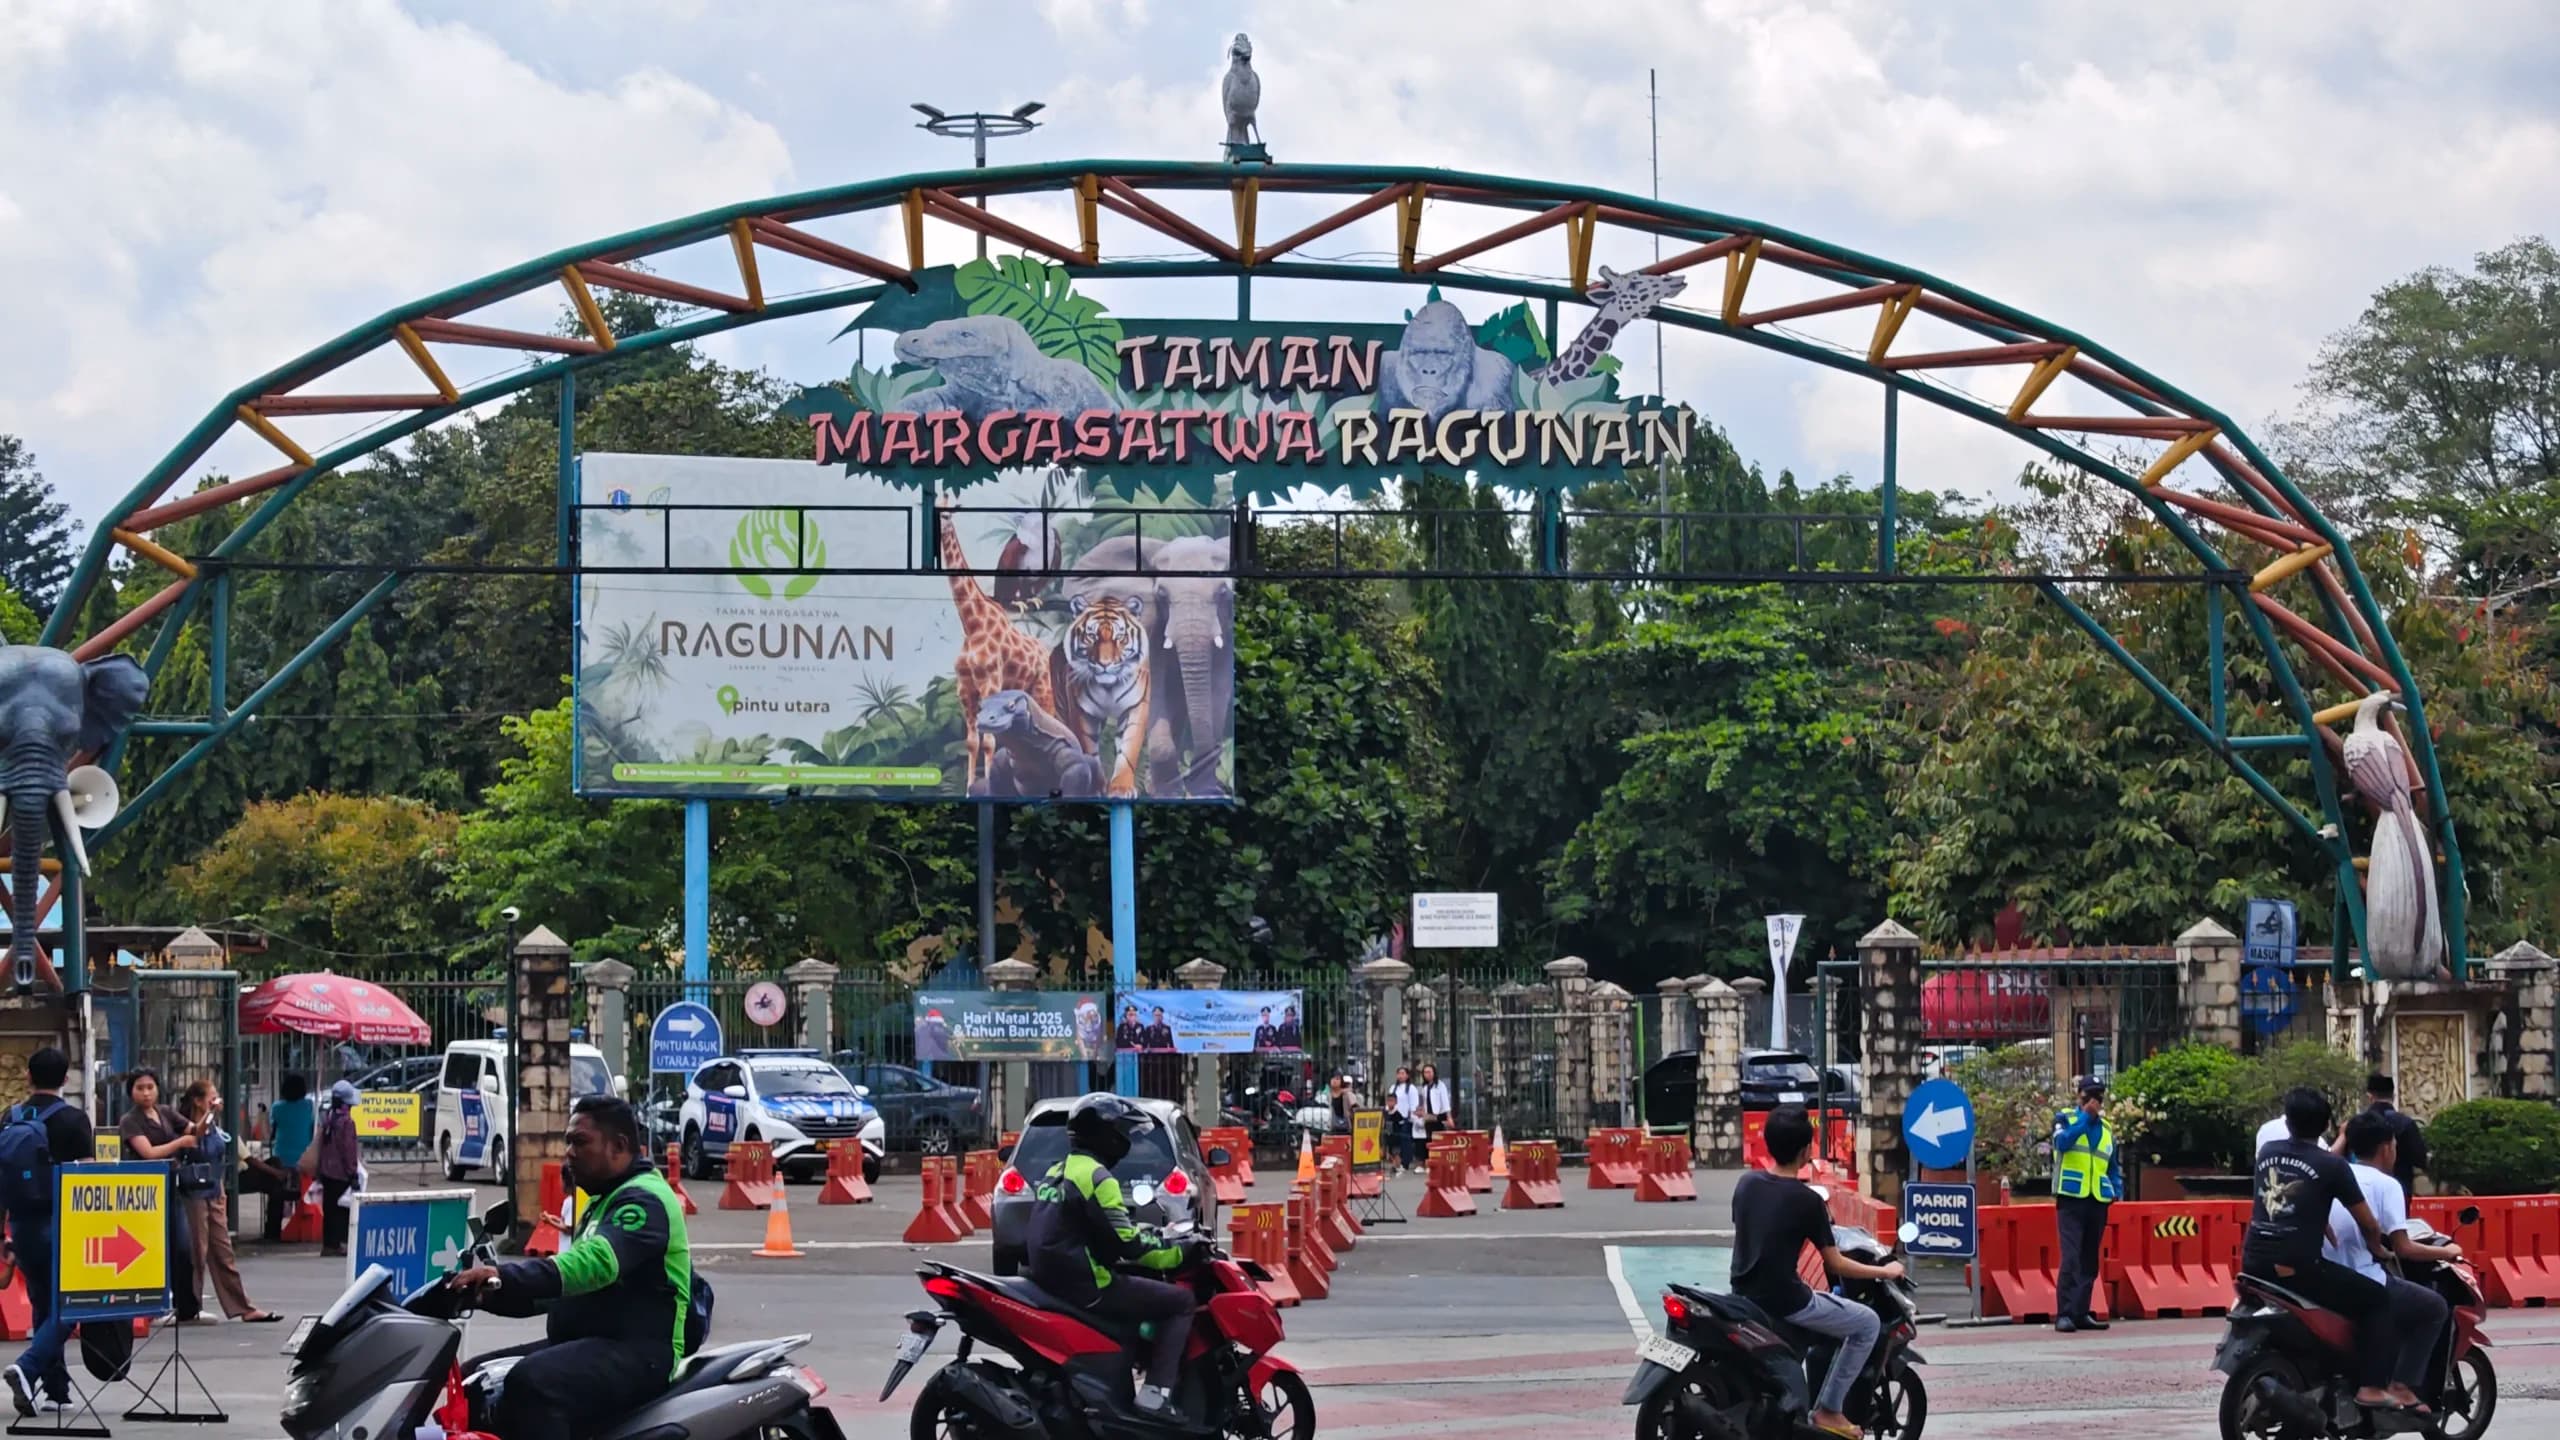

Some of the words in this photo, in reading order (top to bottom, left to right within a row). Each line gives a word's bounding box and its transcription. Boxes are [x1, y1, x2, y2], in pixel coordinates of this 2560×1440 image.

[1116, 335, 1383, 392] TAMAN
[809, 410, 1325, 466] MARGASATWA
[1332, 408, 1697, 466] RAGUNAN
[716, 607, 755, 616] TAMAN
[759, 608, 840, 618] MARGASATWA
[661, 620, 894, 661] RAGUNAN
[733, 698, 779, 714] pintu
[785, 700, 831, 713] utara
[963, 1011, 992, 1025] Hari
[995, 1011, 1030, 1025] Natal
[1032, 1012, 1063, 1025] 2025
[1009, 1025, 1038, 1037] Baru
[1041, 1025, 1073, 1037] 2026
[654, 1040, 682, 1052] PINTU
[682, 1040, 718, 1053] MASUK
[656, 1055, 689, 1067] UTARA
[361, 1097, 382, 1105] INTU
[72, 1185, 113, 1212] MOBIL
[115, 1184, 158, 1212] MASUK
[1912, 1193, 1967, 1208] PARKIR
[1915, 1212, 1965, 1227] MOBIL
[365, 1226, 417, 1257] MASUK
